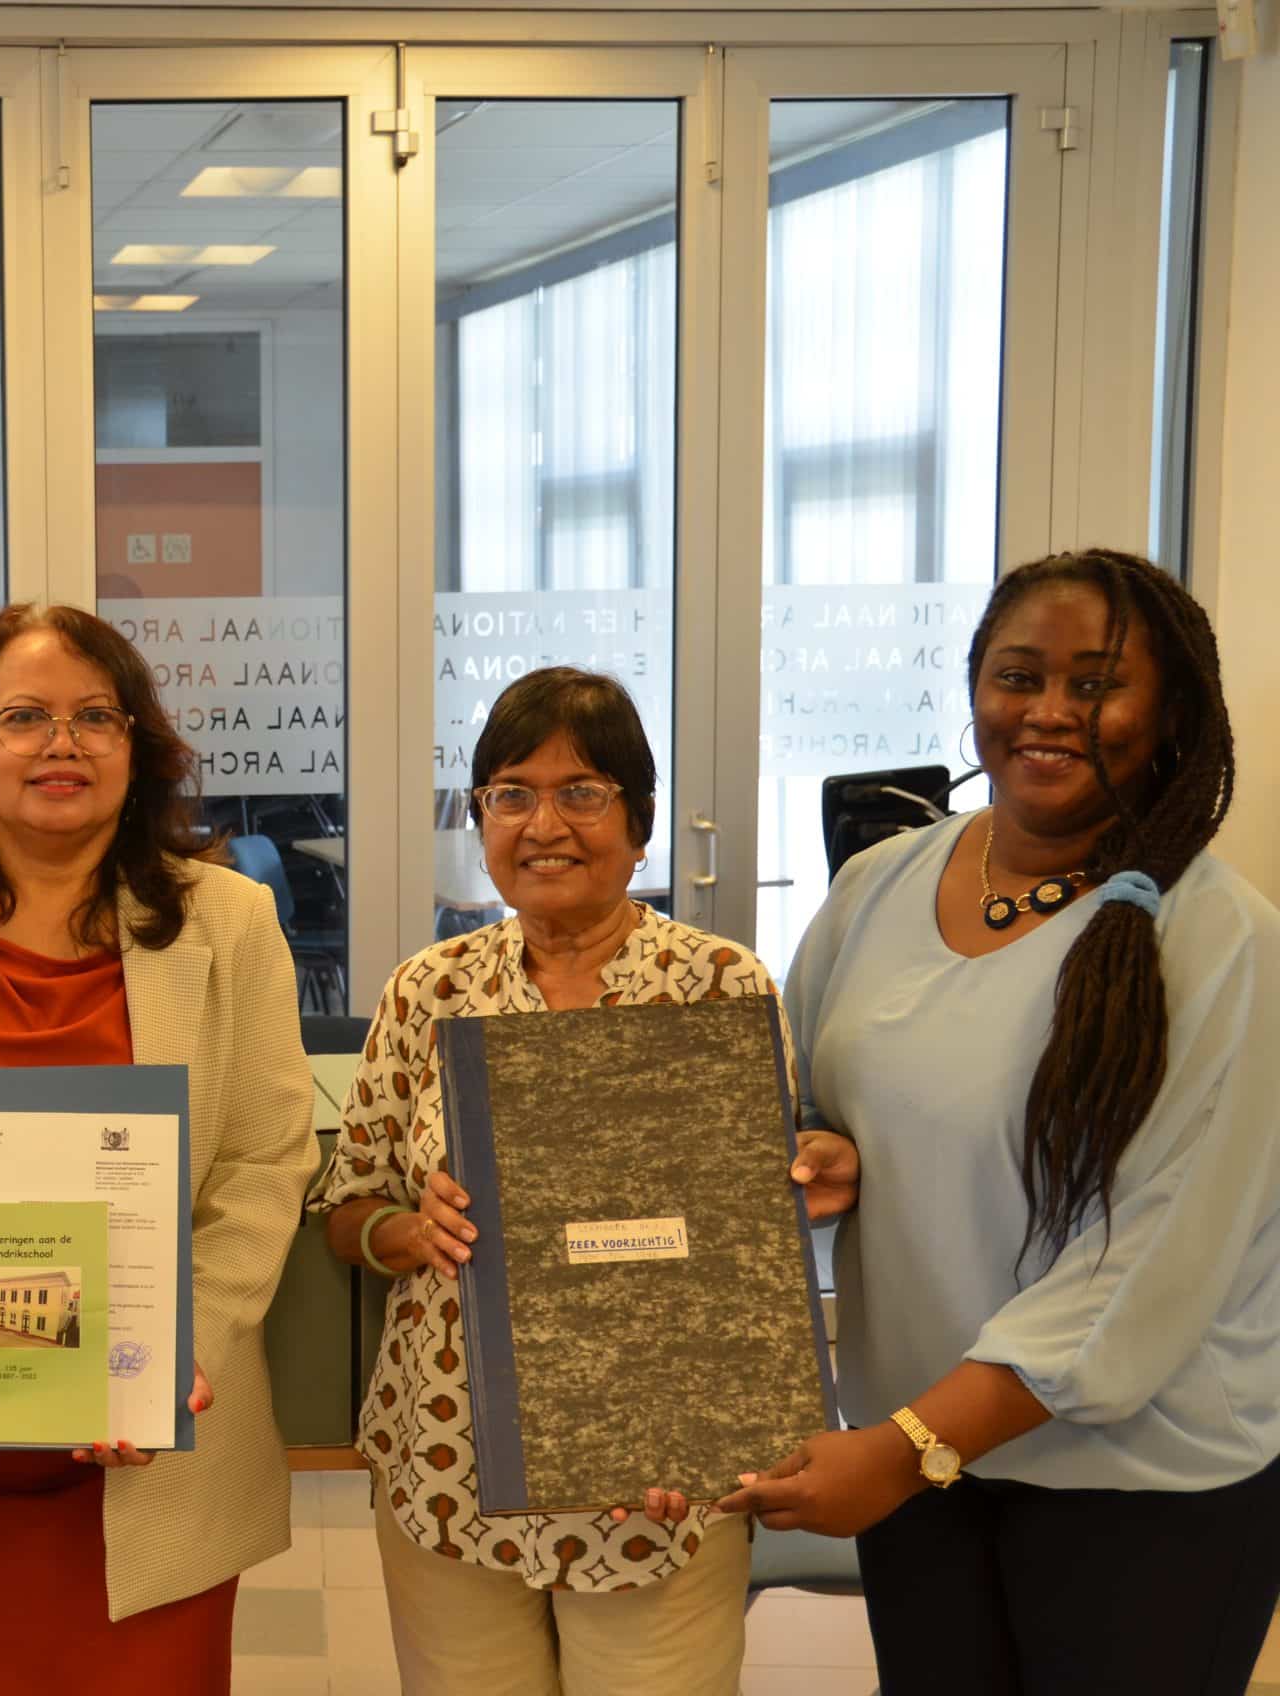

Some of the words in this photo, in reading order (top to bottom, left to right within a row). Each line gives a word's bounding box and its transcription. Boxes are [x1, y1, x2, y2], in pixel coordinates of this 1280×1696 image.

[38, 1235, 56, 1244] aan
[59, 1234, 73, 1244] de
[601, 1235, 676, 1249] VOORZICHTIG
